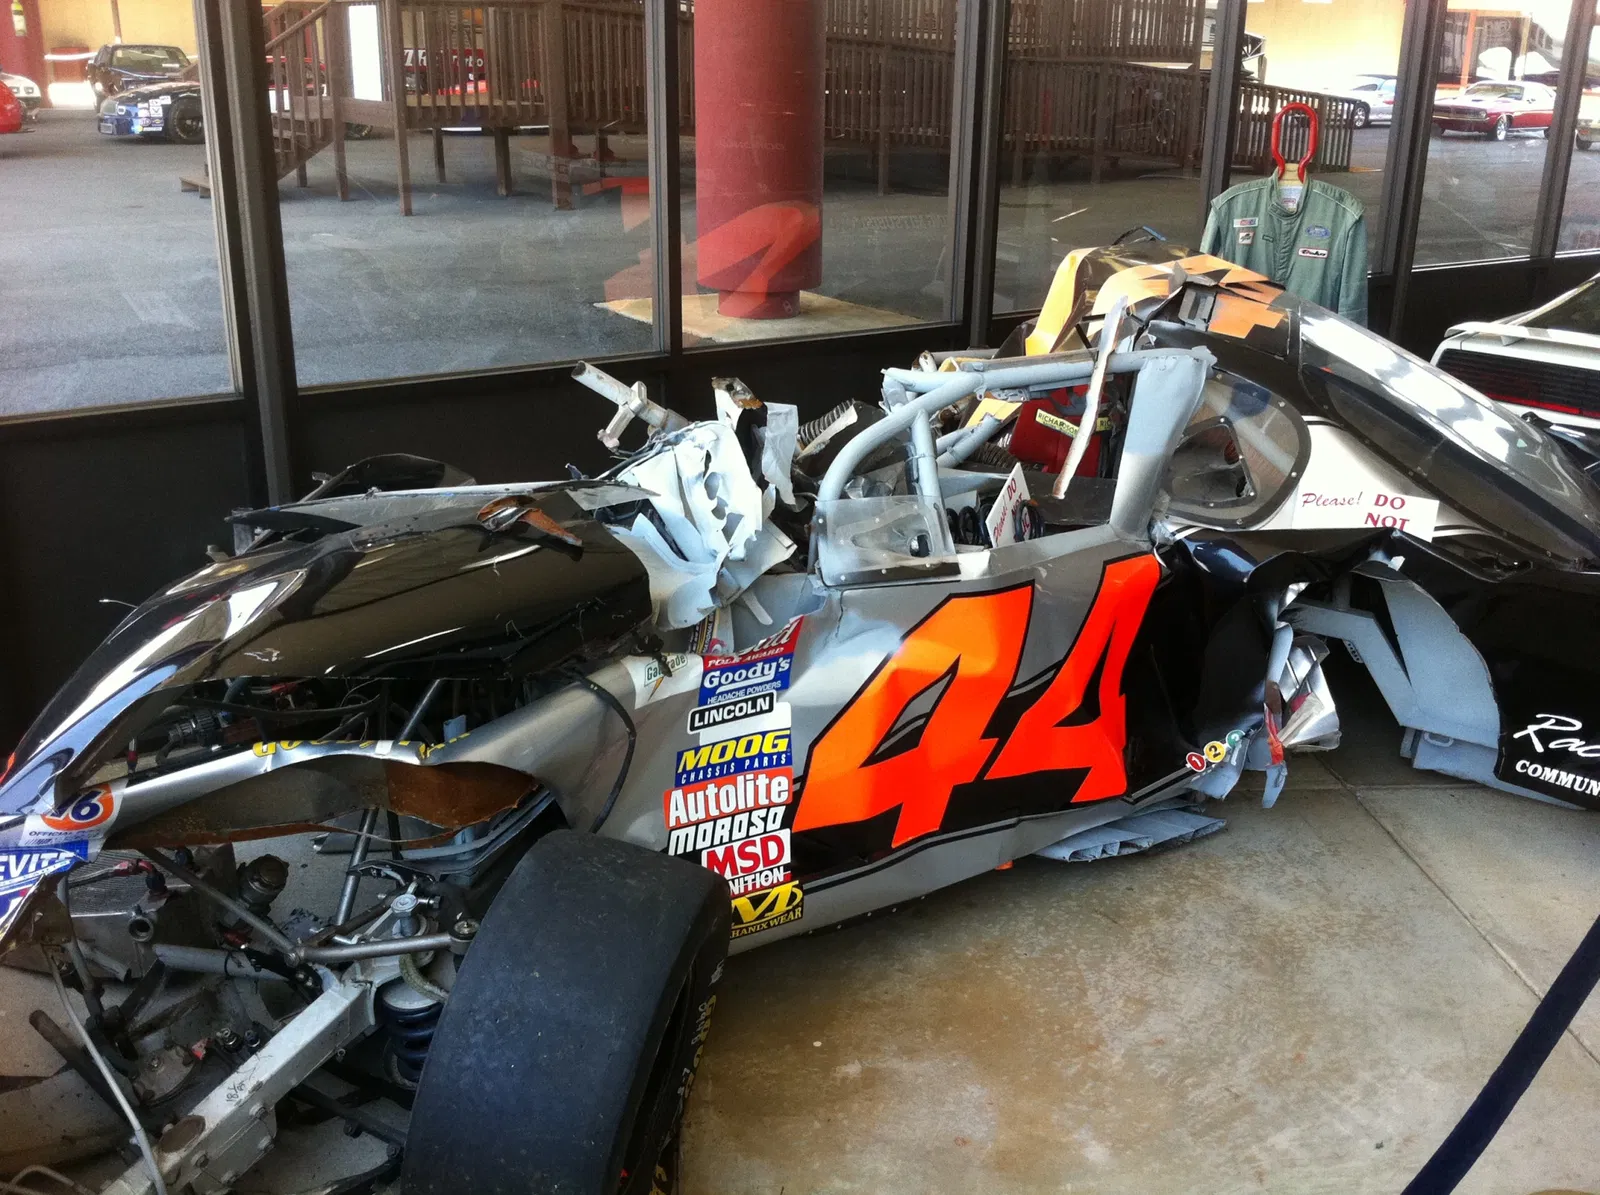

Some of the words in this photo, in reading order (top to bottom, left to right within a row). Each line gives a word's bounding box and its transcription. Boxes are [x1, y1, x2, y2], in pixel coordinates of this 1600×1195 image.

[1007, 478, 1016, 501] DO
[1302, 491, 1363, 508] Please!
[1373, 493, 1406, 510] DO
[1364, 512, 1410, 531] NOT
[647, 653, 686, 681] Gaade
[703, 656, 791, 694] Goody's
[707, 688, 745, 705] HEADACHE
[746, 680, 782, 697] POWDERS
[792, 553, 1161, 849] 44
[694, 696, 770, 728] LINCOLN
[677, 730, 791, 774] MOOG
[1191, 756, 1202, 767] 1
[1209, 745, 1221, 758] 2
[681, 762, 735, 785] CHASSIS
[744, 754, 786, 780] PARTS
[669, 773, 789, 828] Autolite
[707, 834, 785, 878] MSD
[768, 907, 802, 927] WEAR
